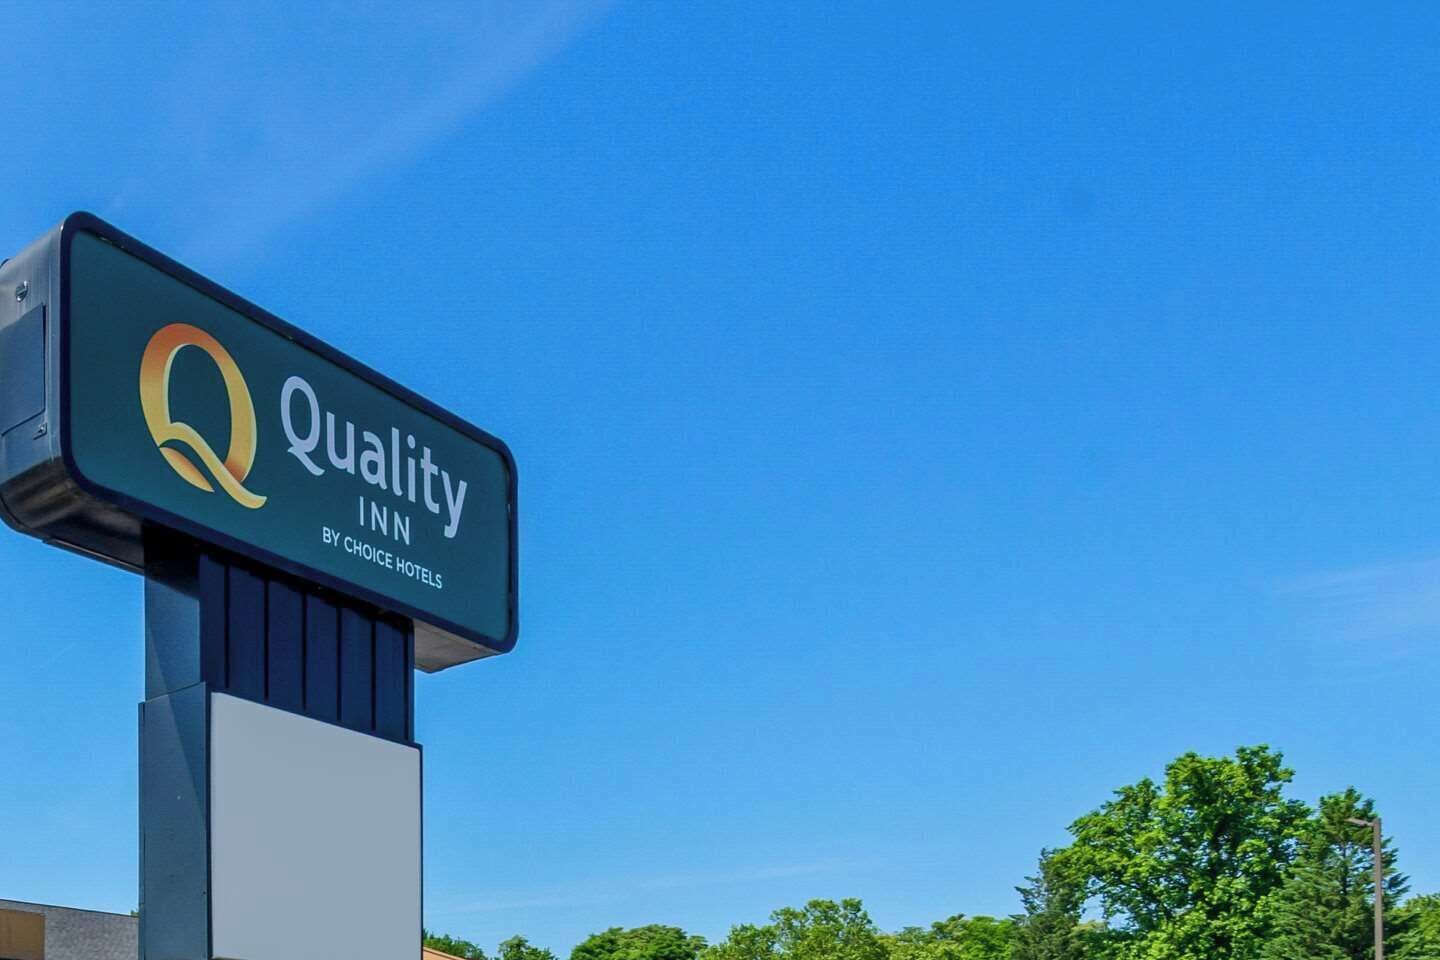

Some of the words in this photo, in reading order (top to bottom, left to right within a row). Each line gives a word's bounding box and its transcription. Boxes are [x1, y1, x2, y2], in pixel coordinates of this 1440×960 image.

[140, 322, 268, 510] Q
[280, 375, 468, 539] Quality
[322, 526, 341, 548] BY
[344, 536, 393, 570] CHOICE
[396, 556, 443, 590] HOTELS
[359, 495, 411, 546] INN
